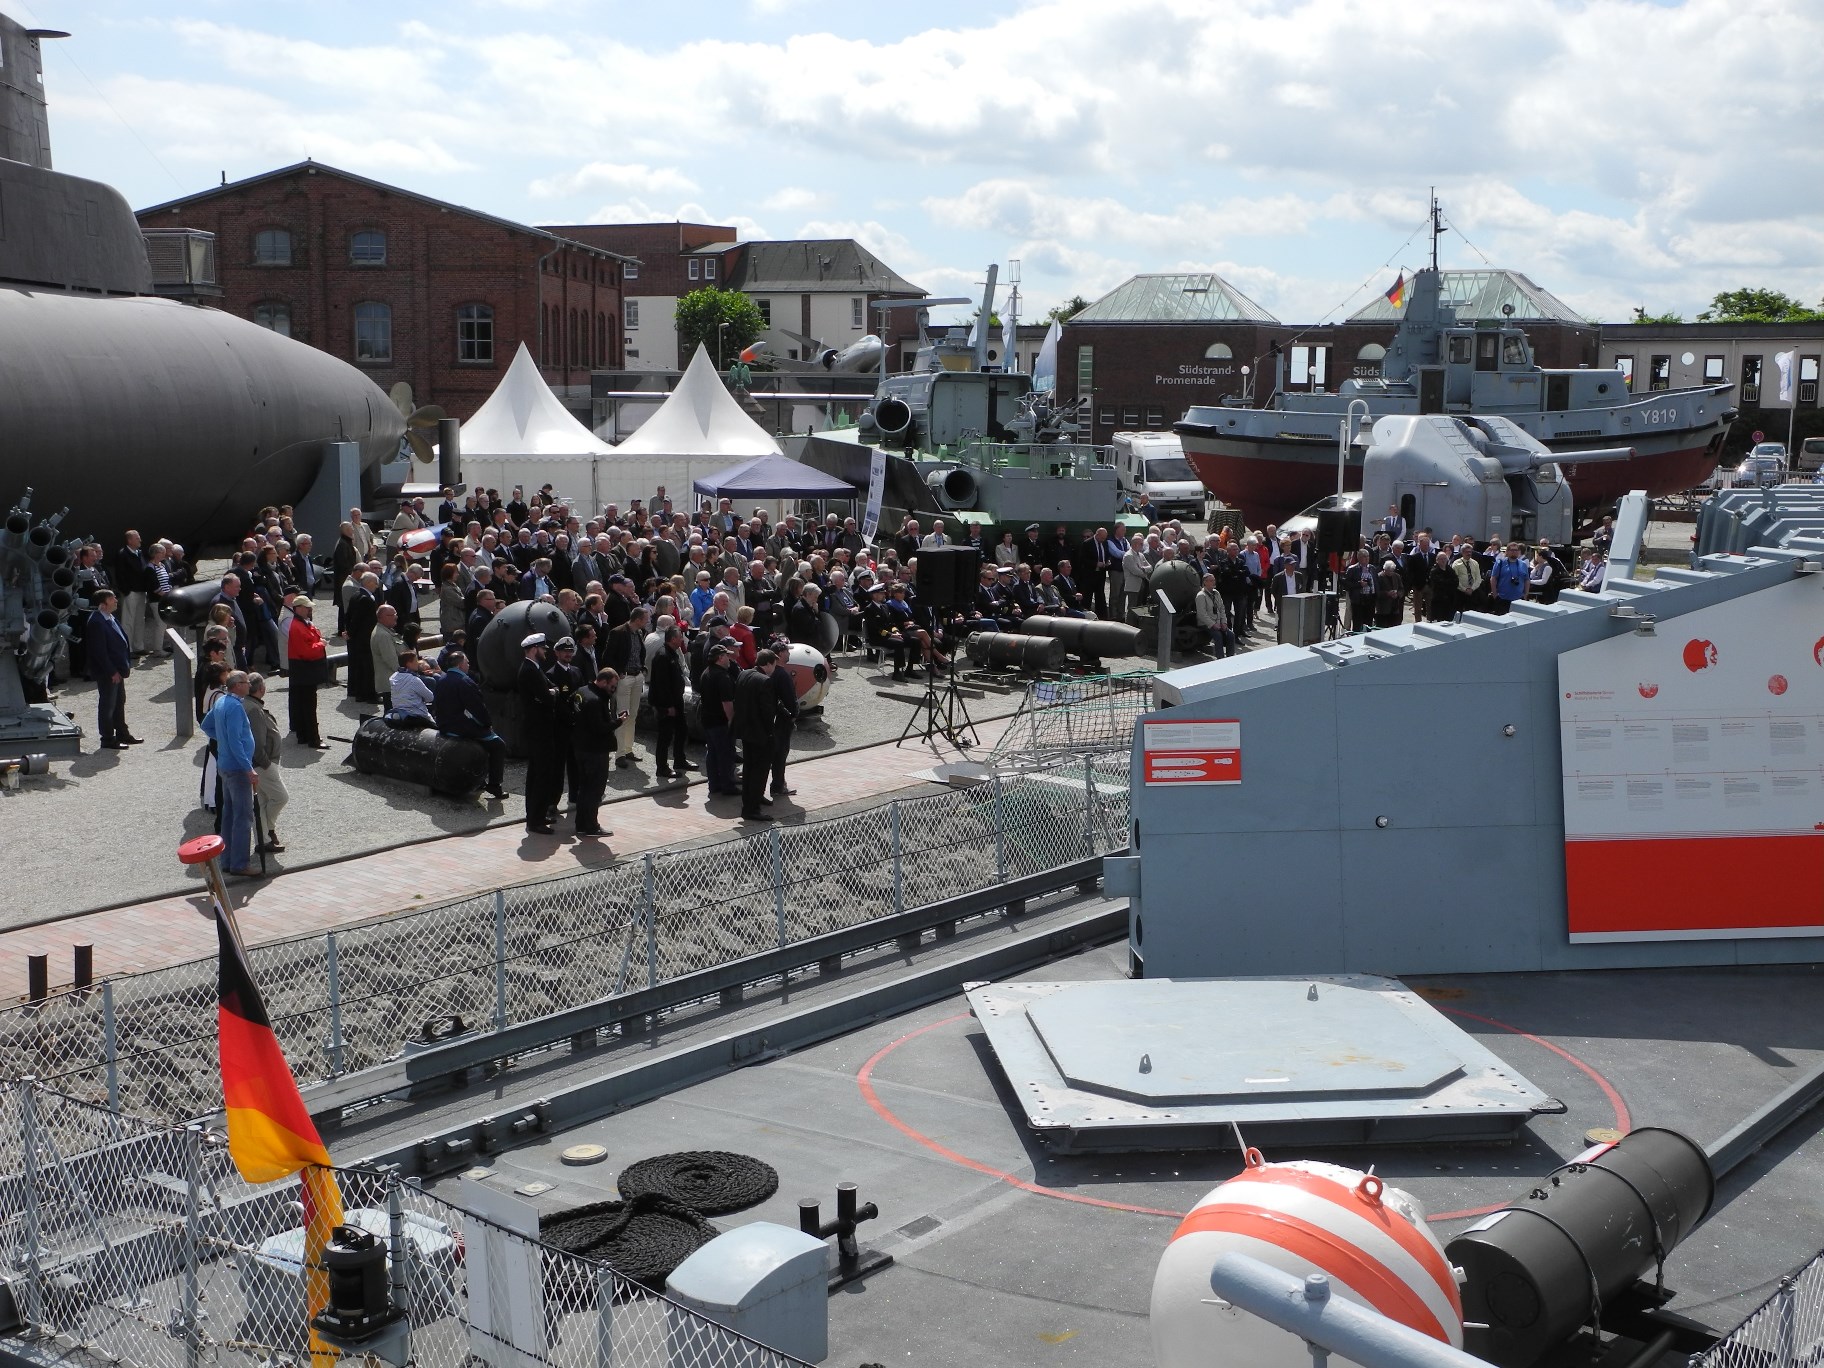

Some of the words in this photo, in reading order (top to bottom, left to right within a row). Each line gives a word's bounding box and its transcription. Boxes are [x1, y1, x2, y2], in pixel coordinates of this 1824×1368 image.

[1178, 364, 1236, 375] Südstrand-
[1155, 374, 1216, 385] Promenade
[1640, 408, 1678, 425] Y819
